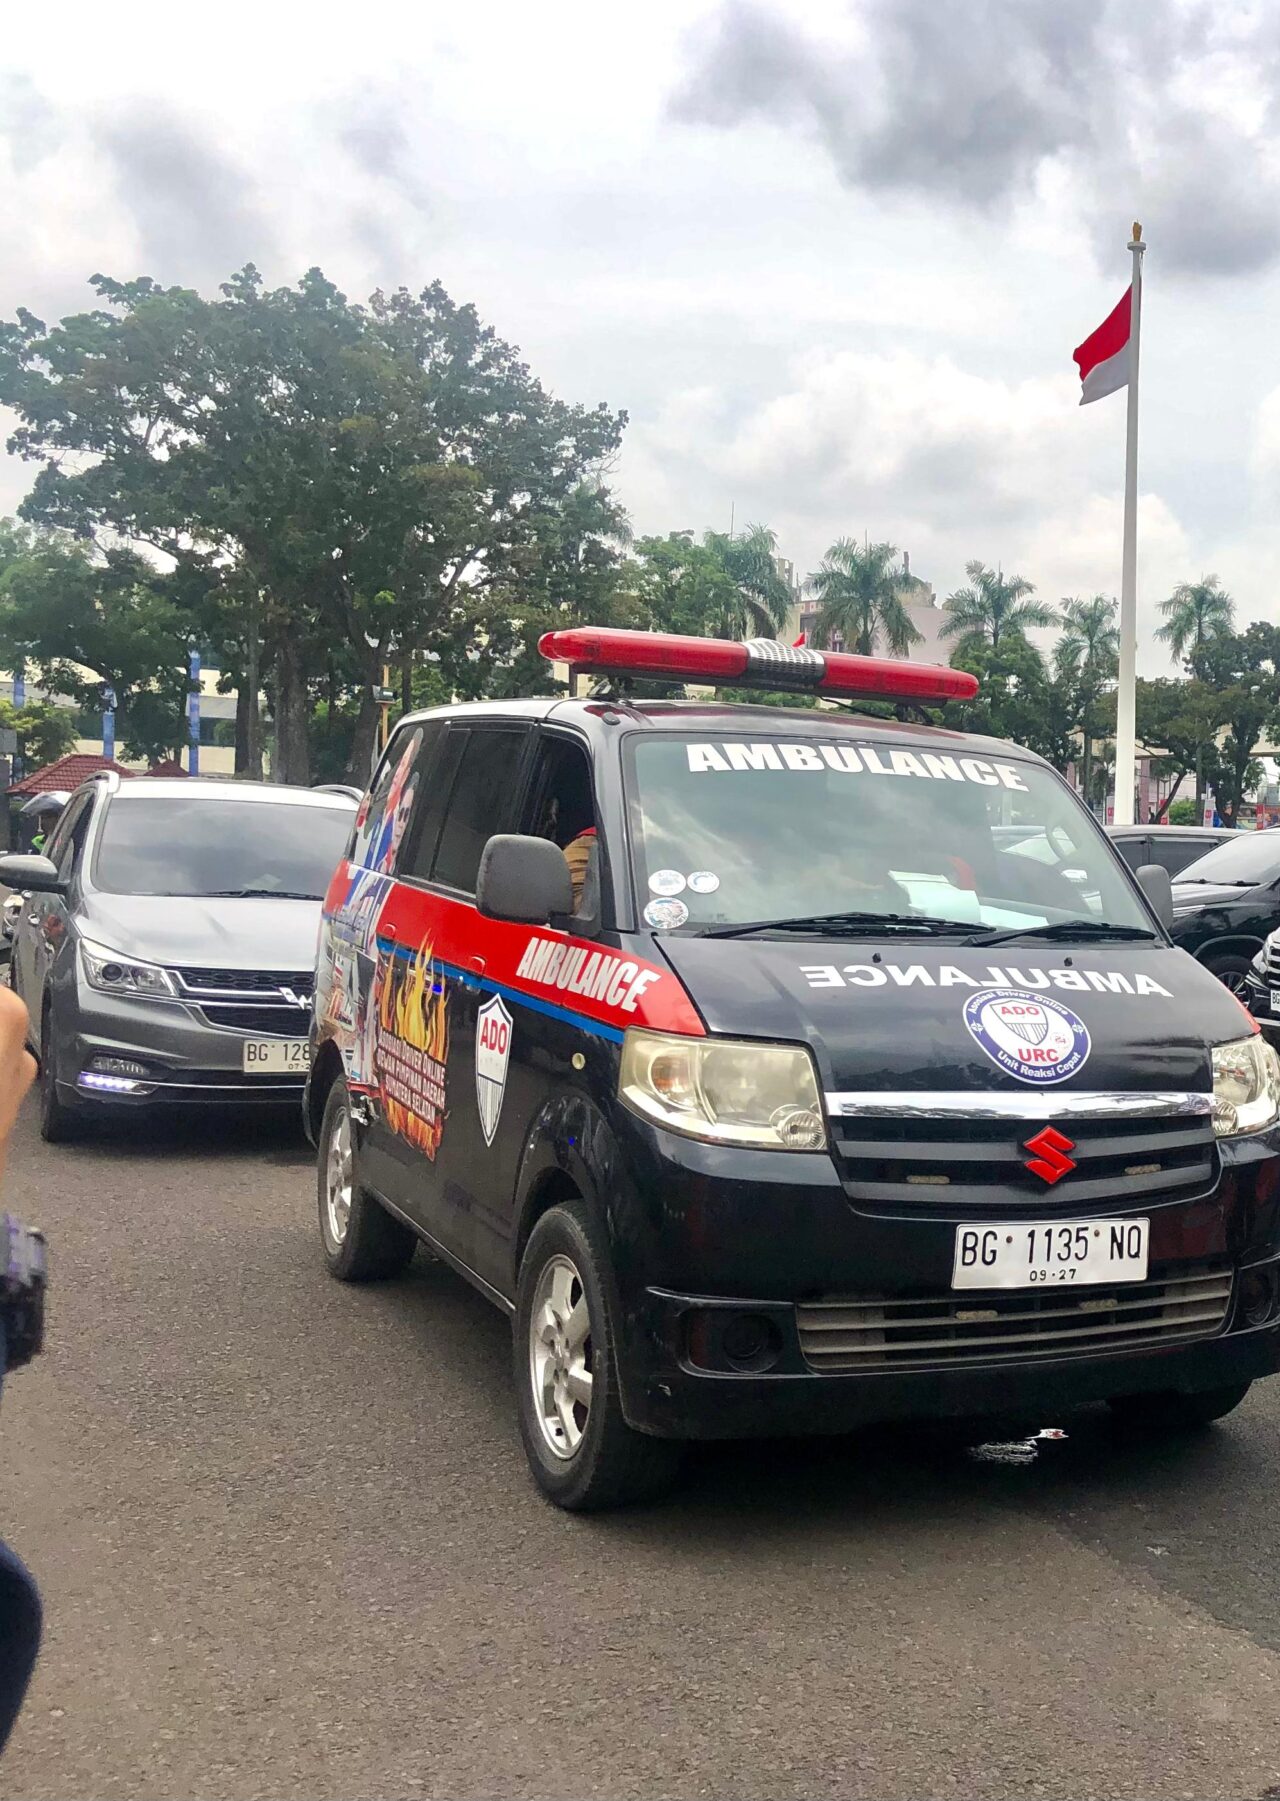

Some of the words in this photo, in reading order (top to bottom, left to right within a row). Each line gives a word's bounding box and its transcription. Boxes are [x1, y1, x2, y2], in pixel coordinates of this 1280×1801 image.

[686, 743, 1030, 792] AMBULANCE
[516, 936, 662, 1013] AMBULANCE
[996, 990, 1032, 999] Driver
[1033, 995, 1069, 1016] Online
[1001, 1006, 1040, 1016] ADO
[1272, 992, 1280, 1005] BG
[480, 1016, 508, 1055] ADO
[247, 1043, 269, 1062] BG
[997, 1050, 1019, 1071] Unit
[1020, 1064, 1056, 1078] Reaksi
[1056, 1051, 1081, 1074] Cepat
[1018, 1048, 1059, 1063] URC
[961, 1230, 998, 1267] BG
[1027, 1226, 1089, 1264] 1135
[1109, 1225, 1142, 1261] NQ
